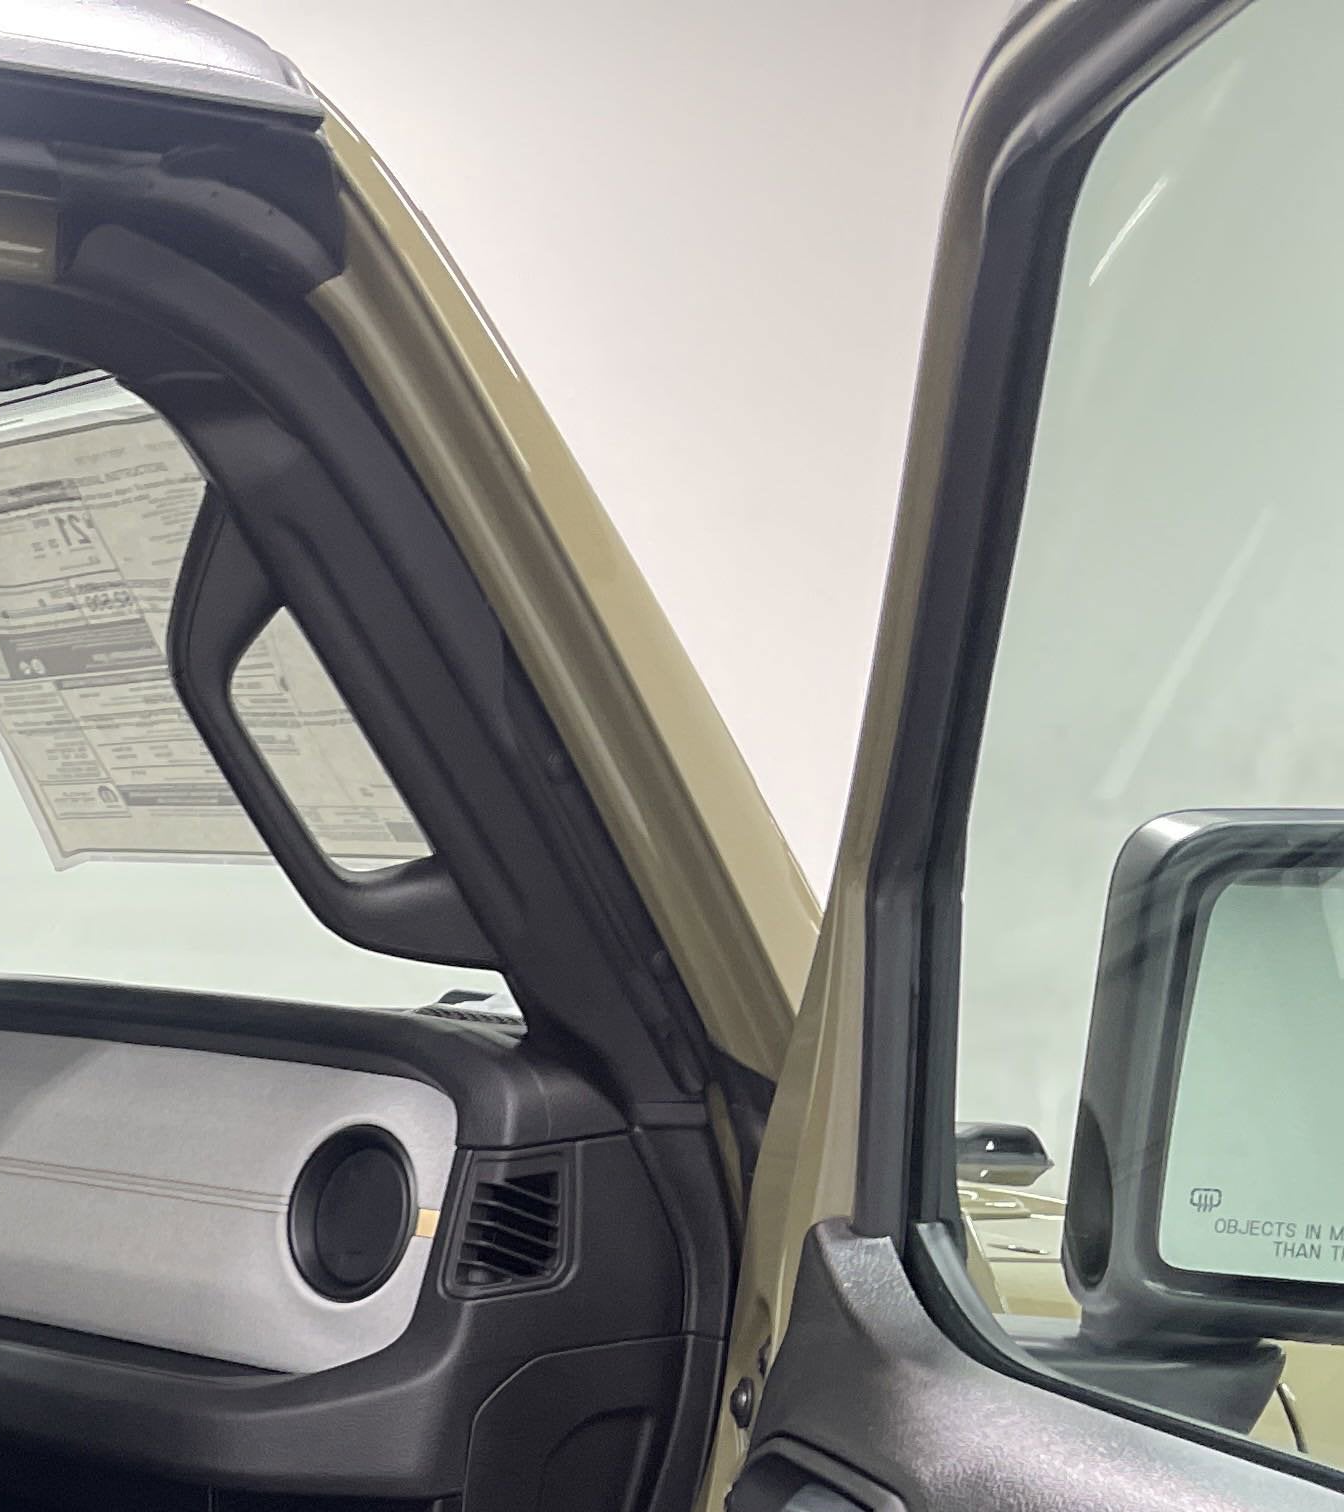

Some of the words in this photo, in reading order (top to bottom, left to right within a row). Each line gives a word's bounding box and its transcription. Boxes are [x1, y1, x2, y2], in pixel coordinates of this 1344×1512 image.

[1214, 1218, 1297, 1238] OBJECTS
[1305, 1224, 1321, 1240] IN
[1273, 1241, 1321, 1260] THAN
